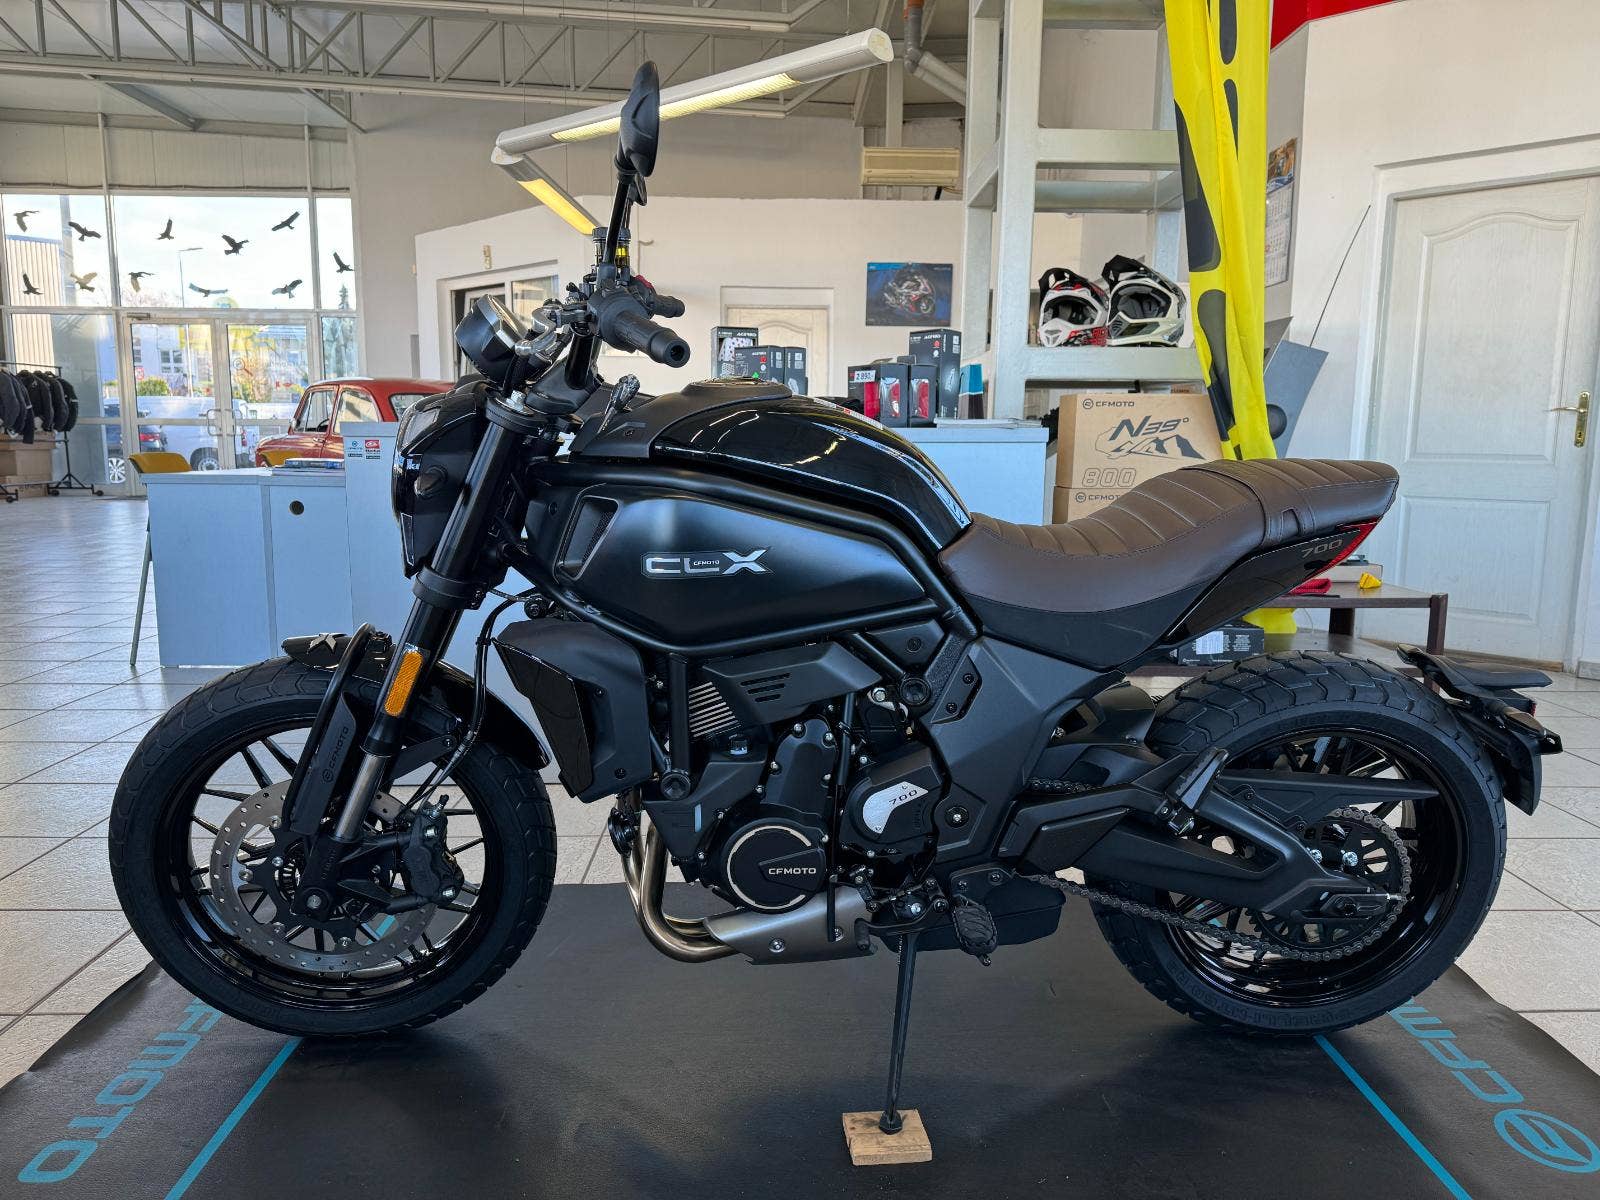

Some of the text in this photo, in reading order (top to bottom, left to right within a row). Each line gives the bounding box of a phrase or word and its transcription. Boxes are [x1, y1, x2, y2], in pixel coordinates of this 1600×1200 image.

[1081, 467, 1137, 487] 800
[1301, 538, 1344, 558] 700
[328, 725, 349, 769] CFMOTO
[888, 789, 918, 805] 700
[768, 867, 817, 875] CFMOTO
[17, 996, 224, 1184] FMOTO
